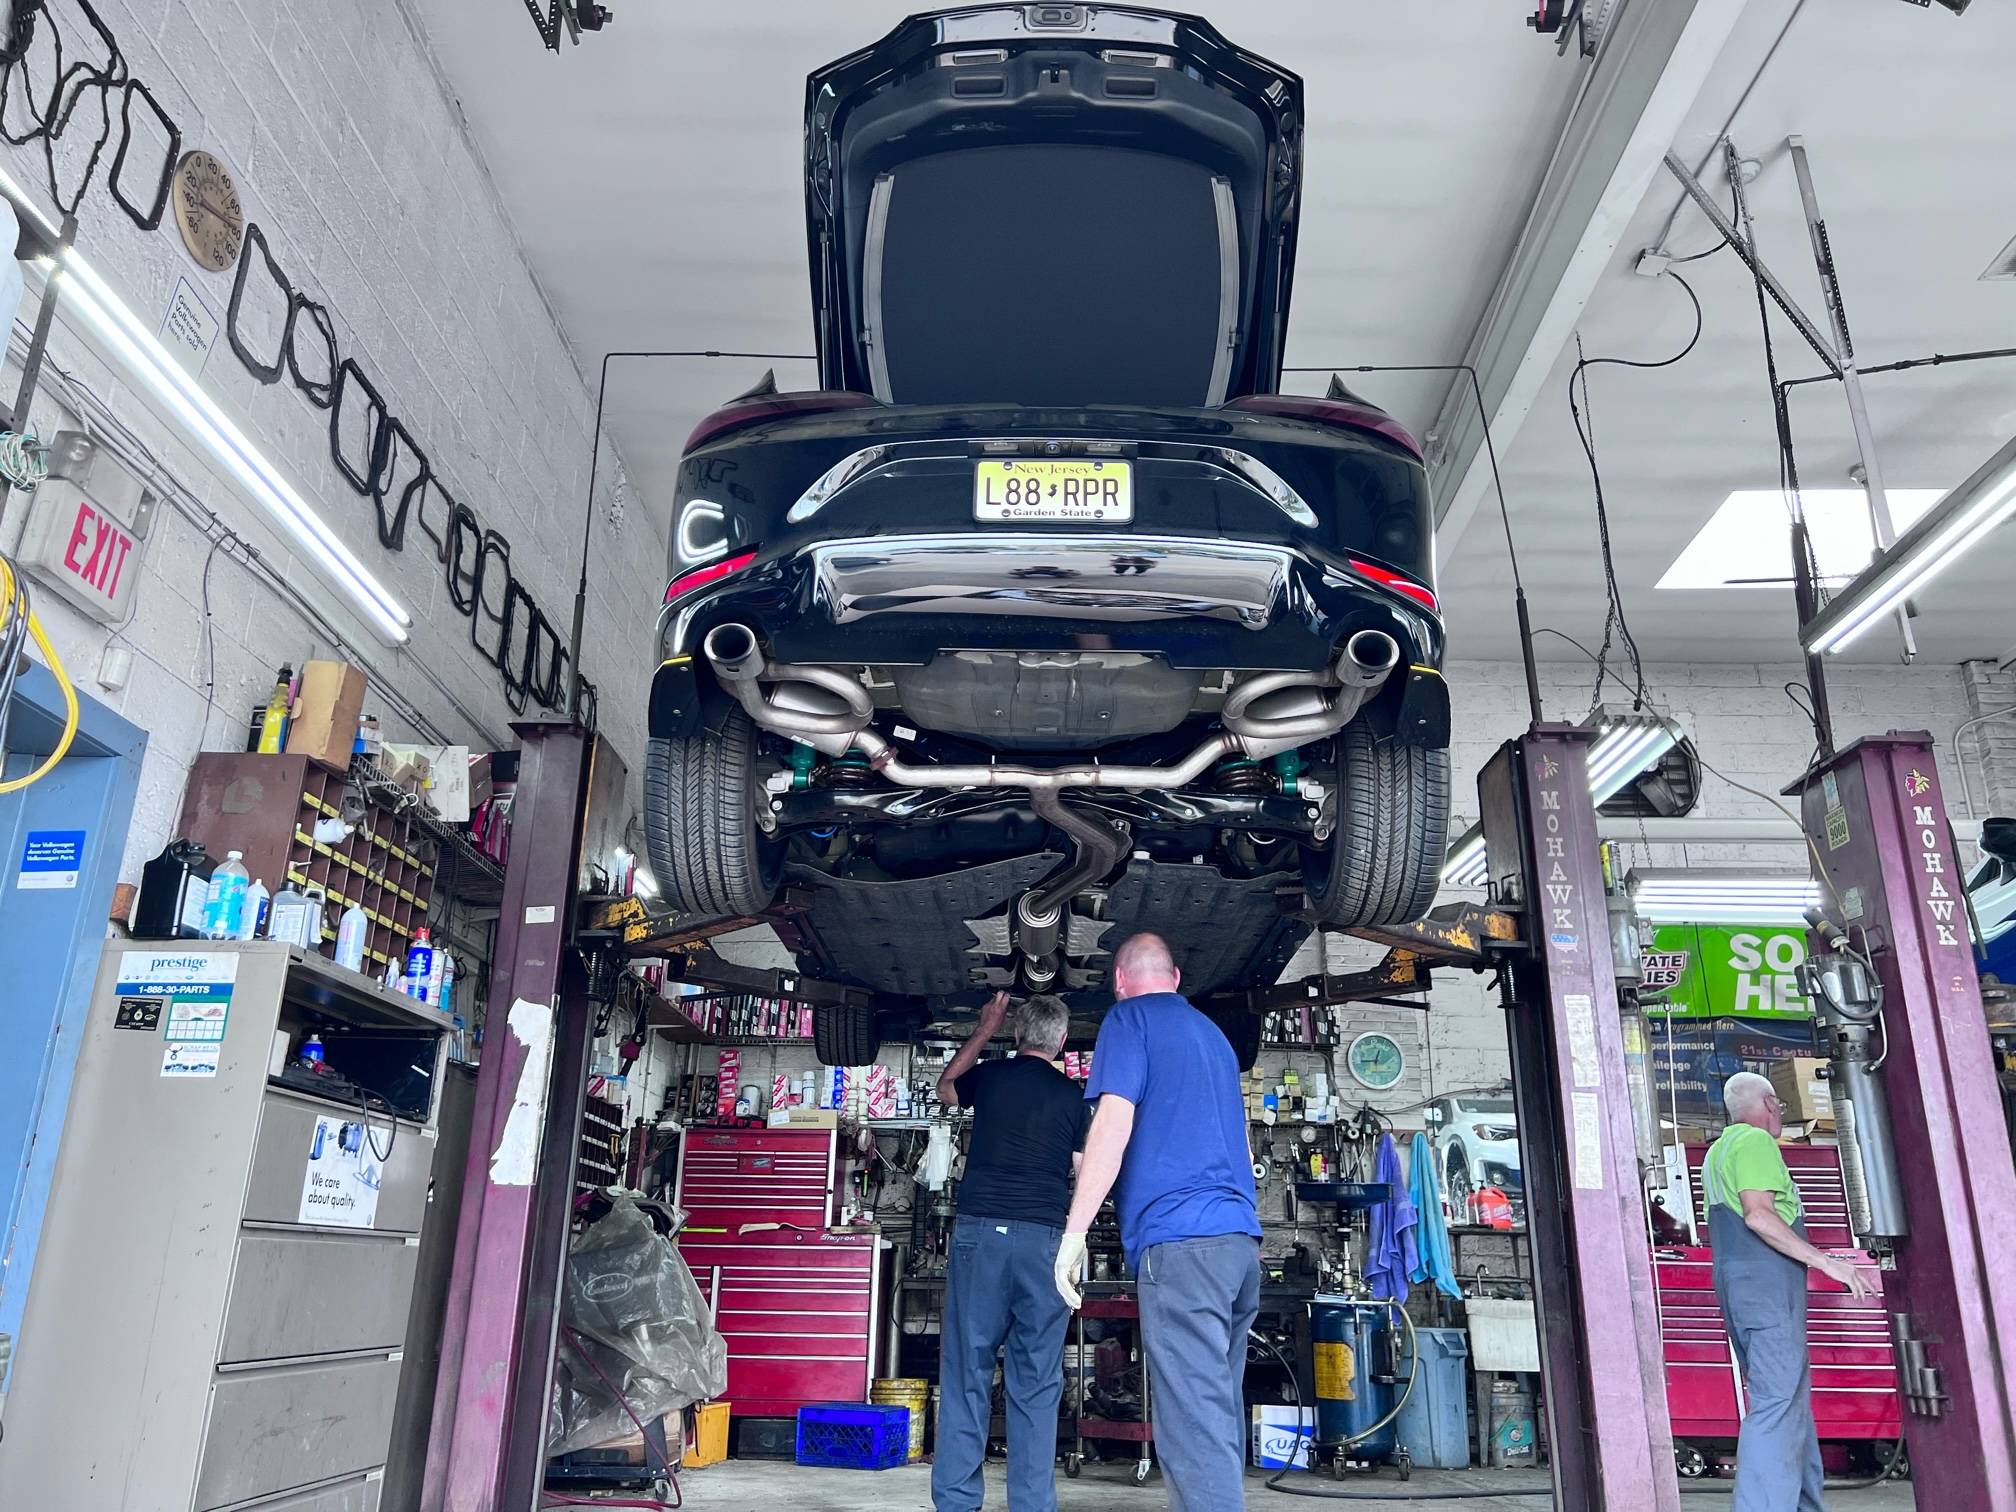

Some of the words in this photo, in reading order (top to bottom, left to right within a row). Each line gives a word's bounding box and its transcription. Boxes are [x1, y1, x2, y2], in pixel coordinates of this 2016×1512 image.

[207, 158, 218, 175] 20
[220, 174, 231, 189] 40
[230, 198, 240, 215] 60
[212, 247, 224, 266] 120
[225, 241, 236, 260] 100
[178, 294, 201, 329] Genuine
[175, 302, 207, 351] Volkswagen
[186, 334, 199, 351] sold
[1014, 463, 1046, 474] New
[1047, 463, 1092, 476] Jersey
[985, 477, 1042, 506] L88
[1063, 478, 1119, 507] RPR
[1013, 508, 1056, 517] Garden
[1060, 508, 1092, 517] State
[63, 501, 133, 601] EXIT
[1829, 820, 1847, 841] 9000
[1540, 790, 1574, 929] MOHAWK
[1913, 806, 1958, 945] MOHAWK
[1642, 955, 1683, 967] TATE
[1728, 933, 1805, 972] SO
[150, 955, 208, 973] prestige
[1646, 970, 1677, 983] IES
[138, 985, 210, 994] 1-888-30-PARTS
[1735, 974, 1808, 1012] HE
[1653, 1060, 1691, 1072] ileage
[1655, 1080, 1707, 1092] relability
[311, 1171, 323, 1188] We
[324, 1177, 341, 1189] care
[307, 1189, 331, 1204] about
[330, 1191, 356, 1211] quality.
